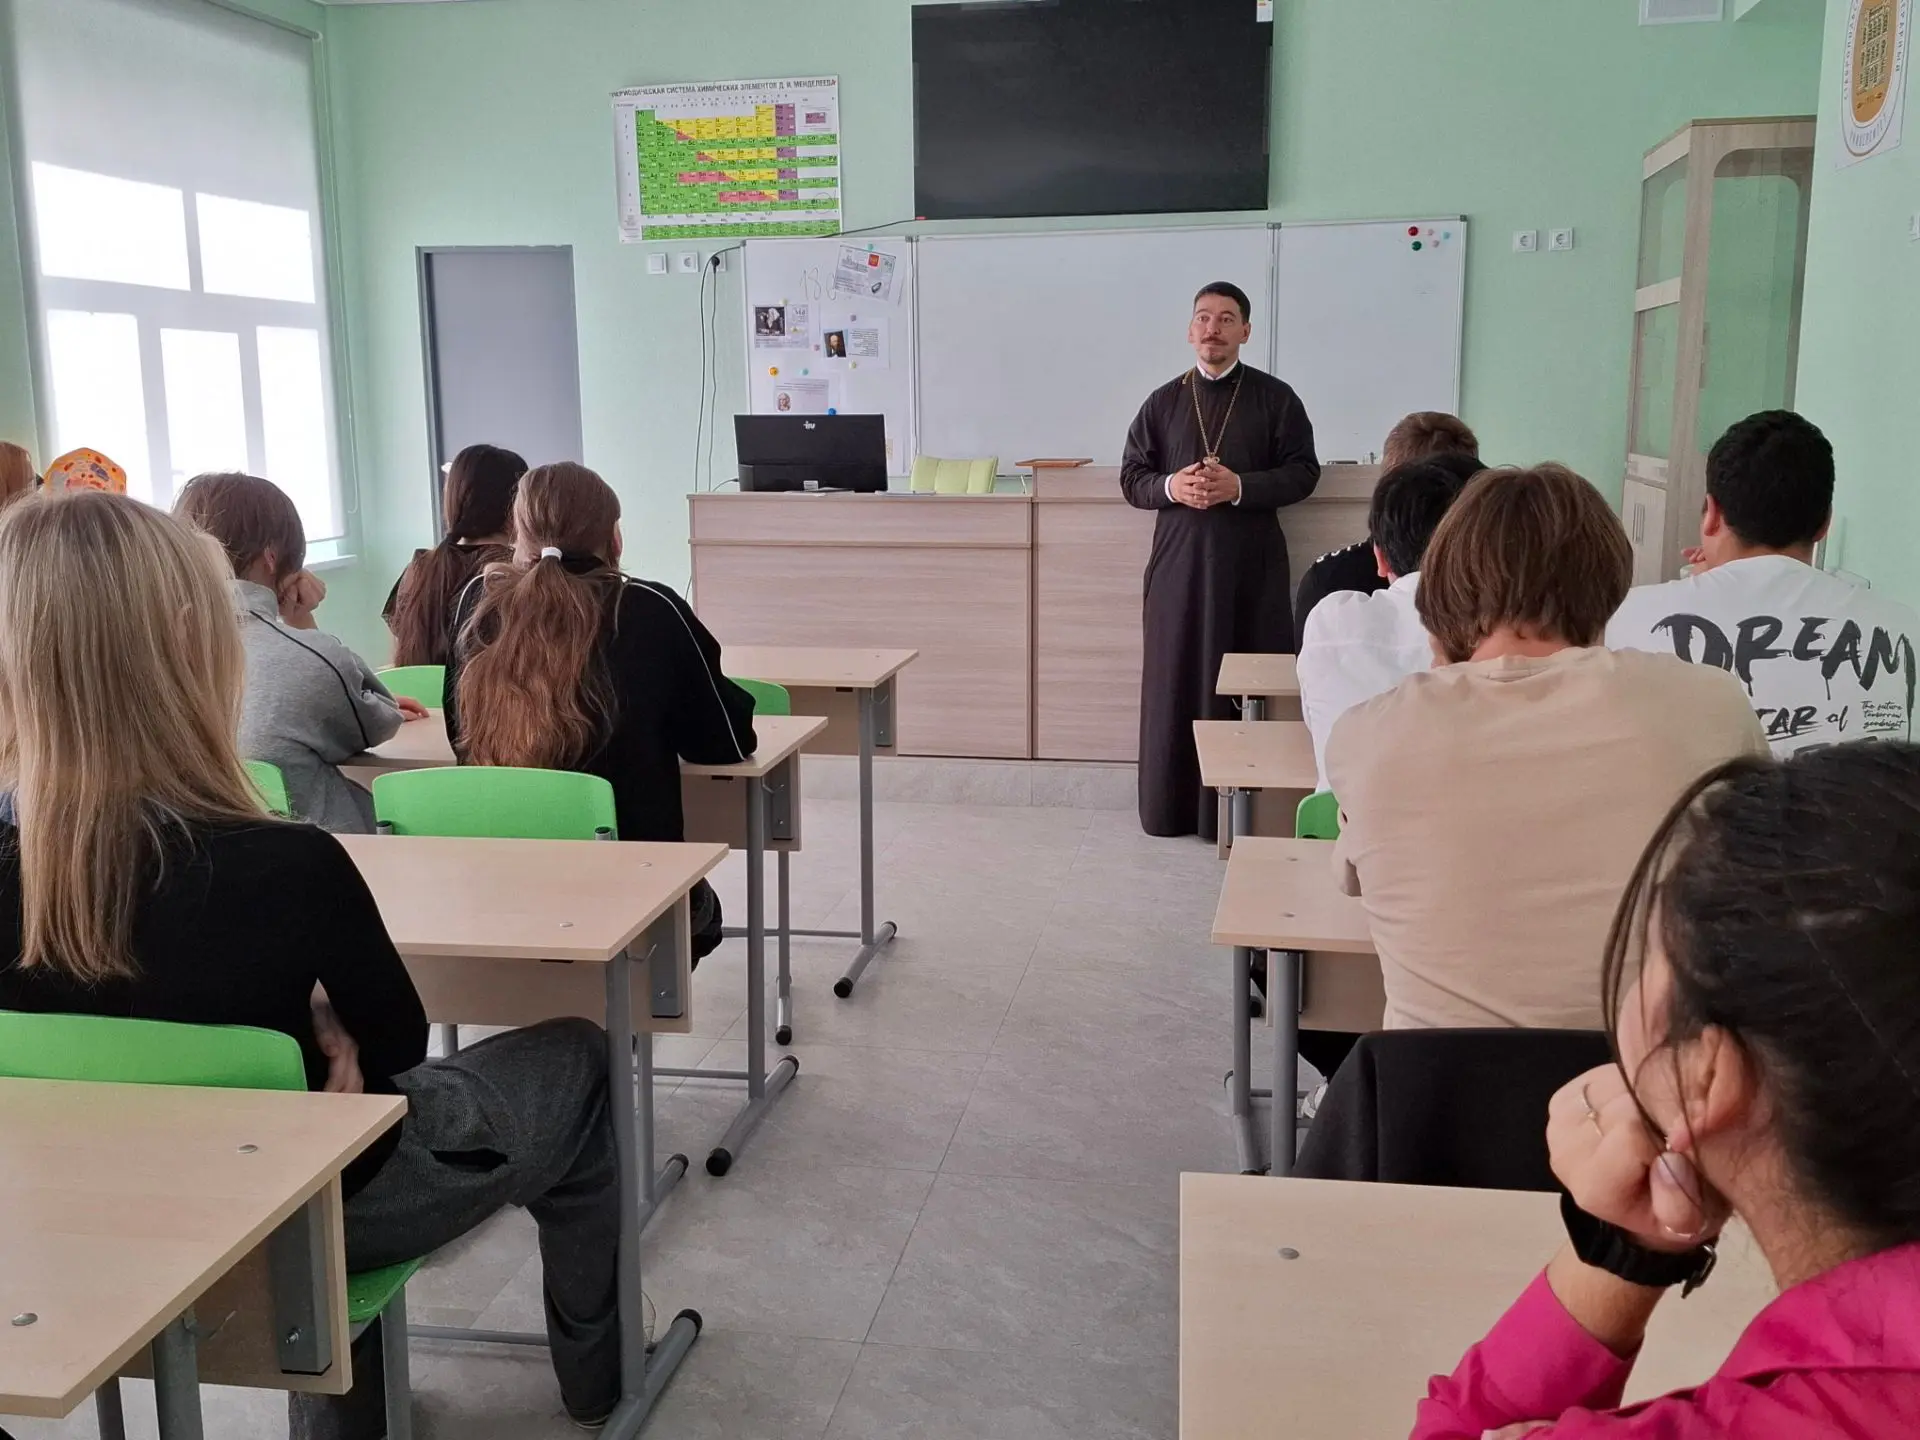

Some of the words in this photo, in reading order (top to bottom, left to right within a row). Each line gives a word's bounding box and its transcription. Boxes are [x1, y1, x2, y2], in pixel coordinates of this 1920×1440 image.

[666, 86, 696, 95] СИСТЕМА
[697, 84, 739, 93] ХИМИЧЕСКИХ
[740, 82, 777, 91] ЭЛЕМЕНТОВ
[793, 79, 836, 88] МЕНДЕЛЕЕВА
[1651, 613, 1916, 738] DREAM
